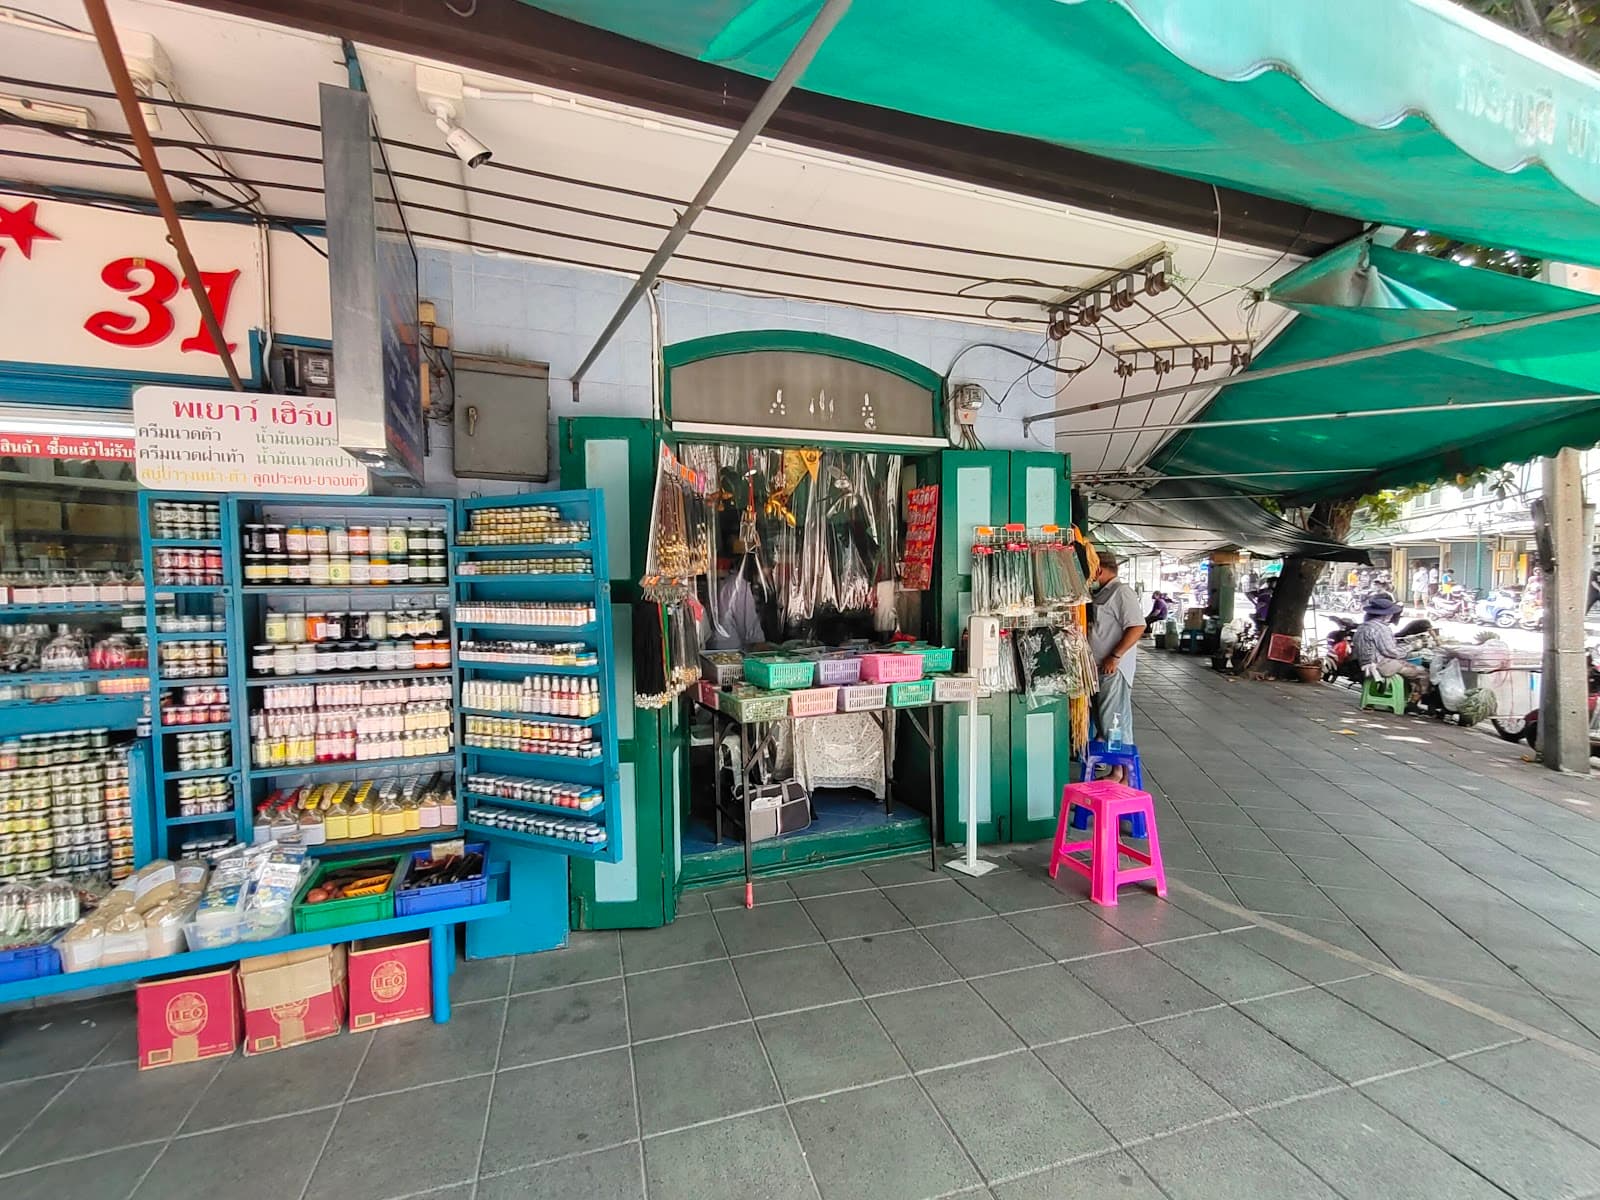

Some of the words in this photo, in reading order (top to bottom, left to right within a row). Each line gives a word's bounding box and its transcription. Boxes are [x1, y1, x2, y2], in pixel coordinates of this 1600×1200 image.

[84, 257, 241, 355] 31
[172, 399, 259, 422] พเยาว์
[272, 400, 332, 427] เฮิร์บ
[139, 423, 221, 442] ครีมนวดตัว
[0, 438, 40, 454] สินค้า
[139, 444, 245, 463] ครีมนวดฝ่าเท้า
